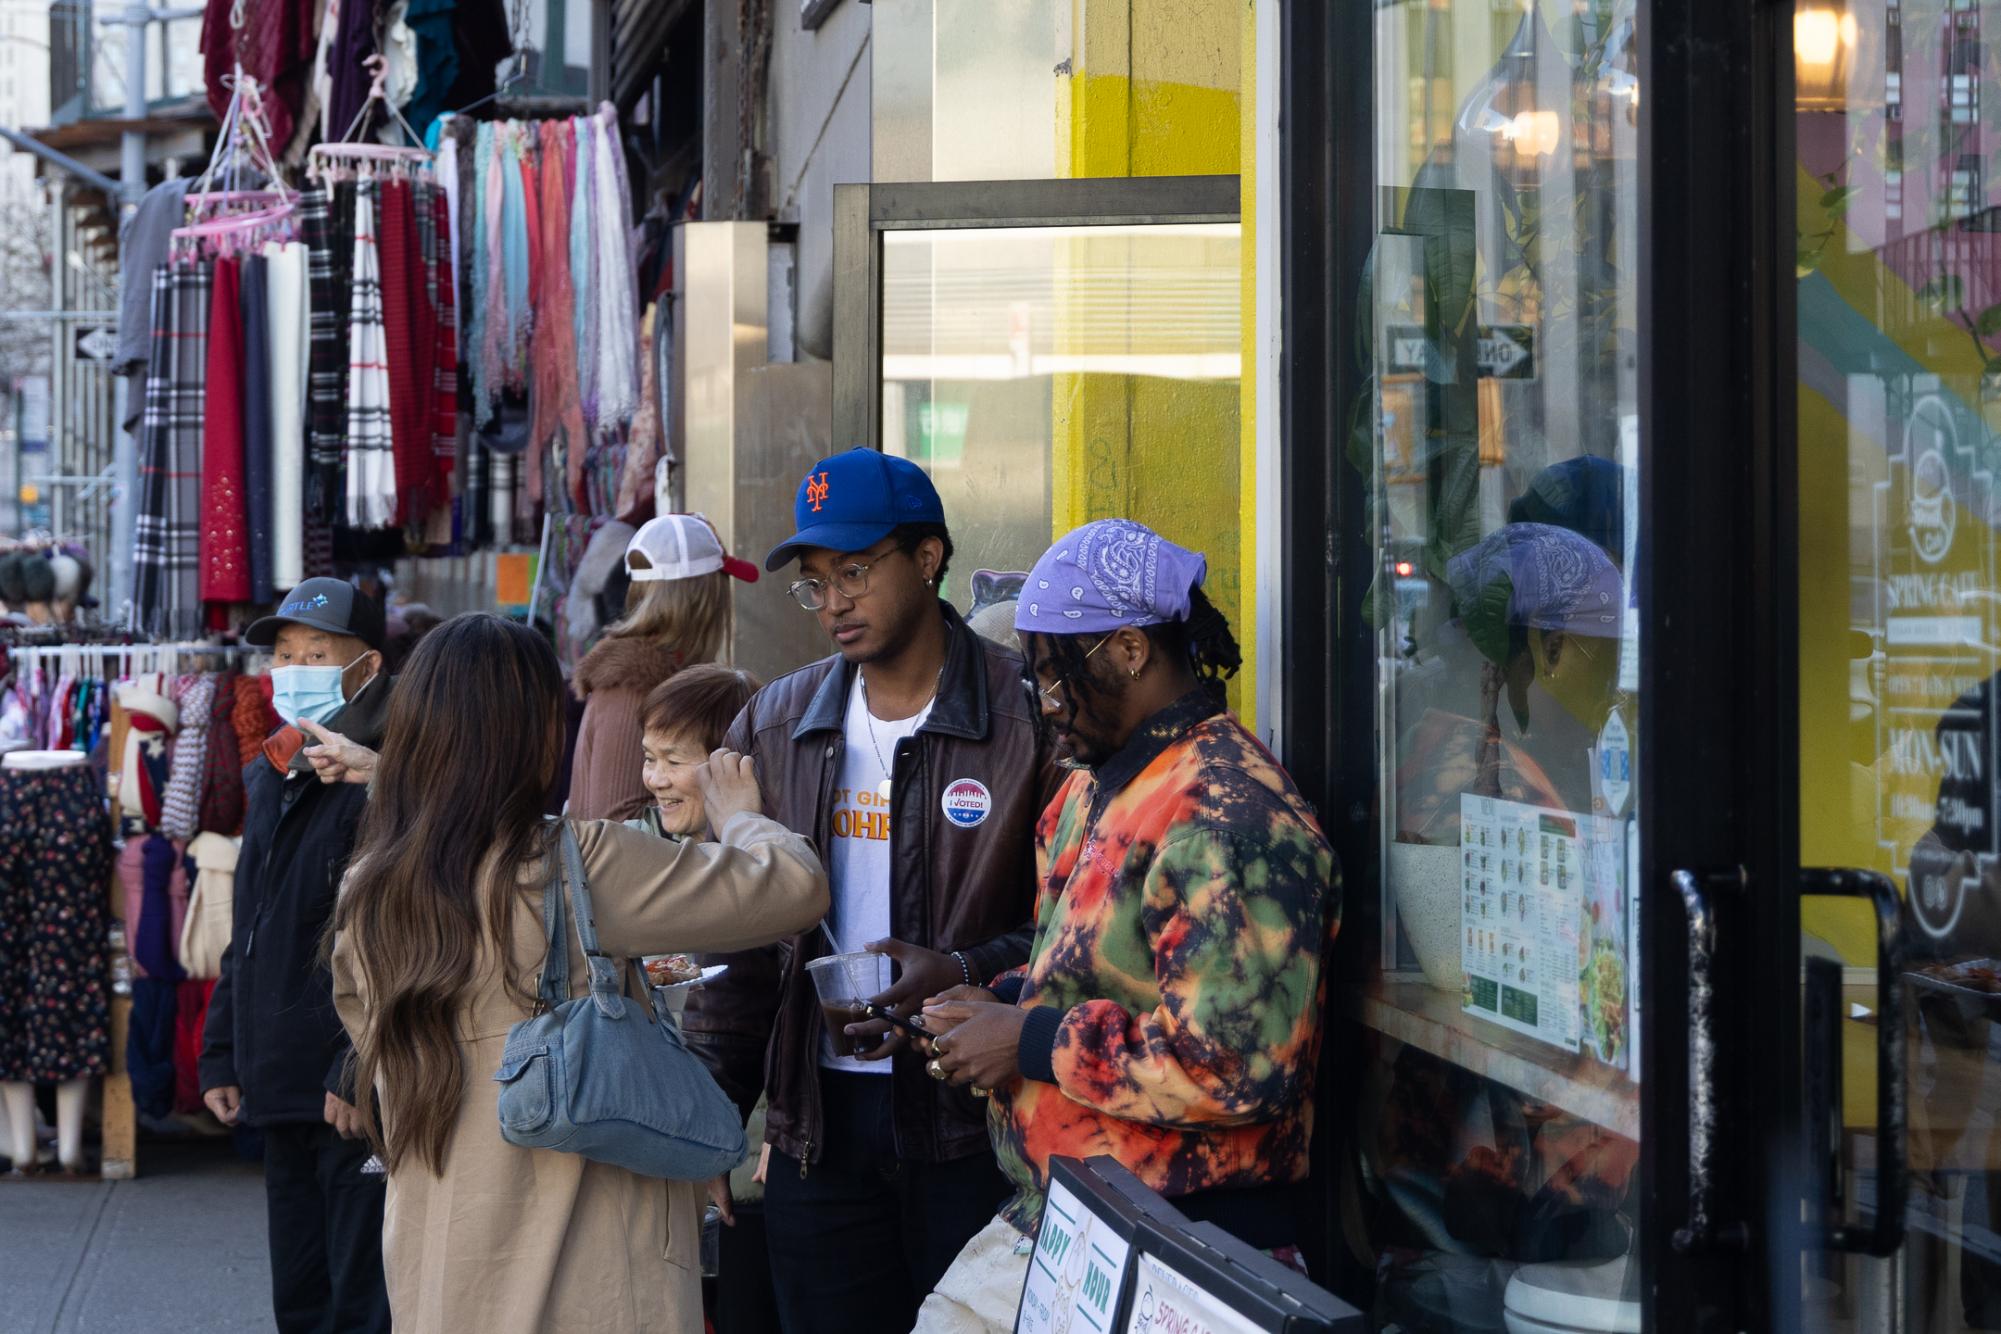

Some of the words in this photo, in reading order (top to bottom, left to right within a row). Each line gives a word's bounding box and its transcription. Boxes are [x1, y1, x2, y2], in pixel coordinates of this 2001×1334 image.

[807, 472, 829, 512] NY
[1040, 1214, 1072, 1266] HAPPY
[1082, 1260, 1111, 1314] HOUR
